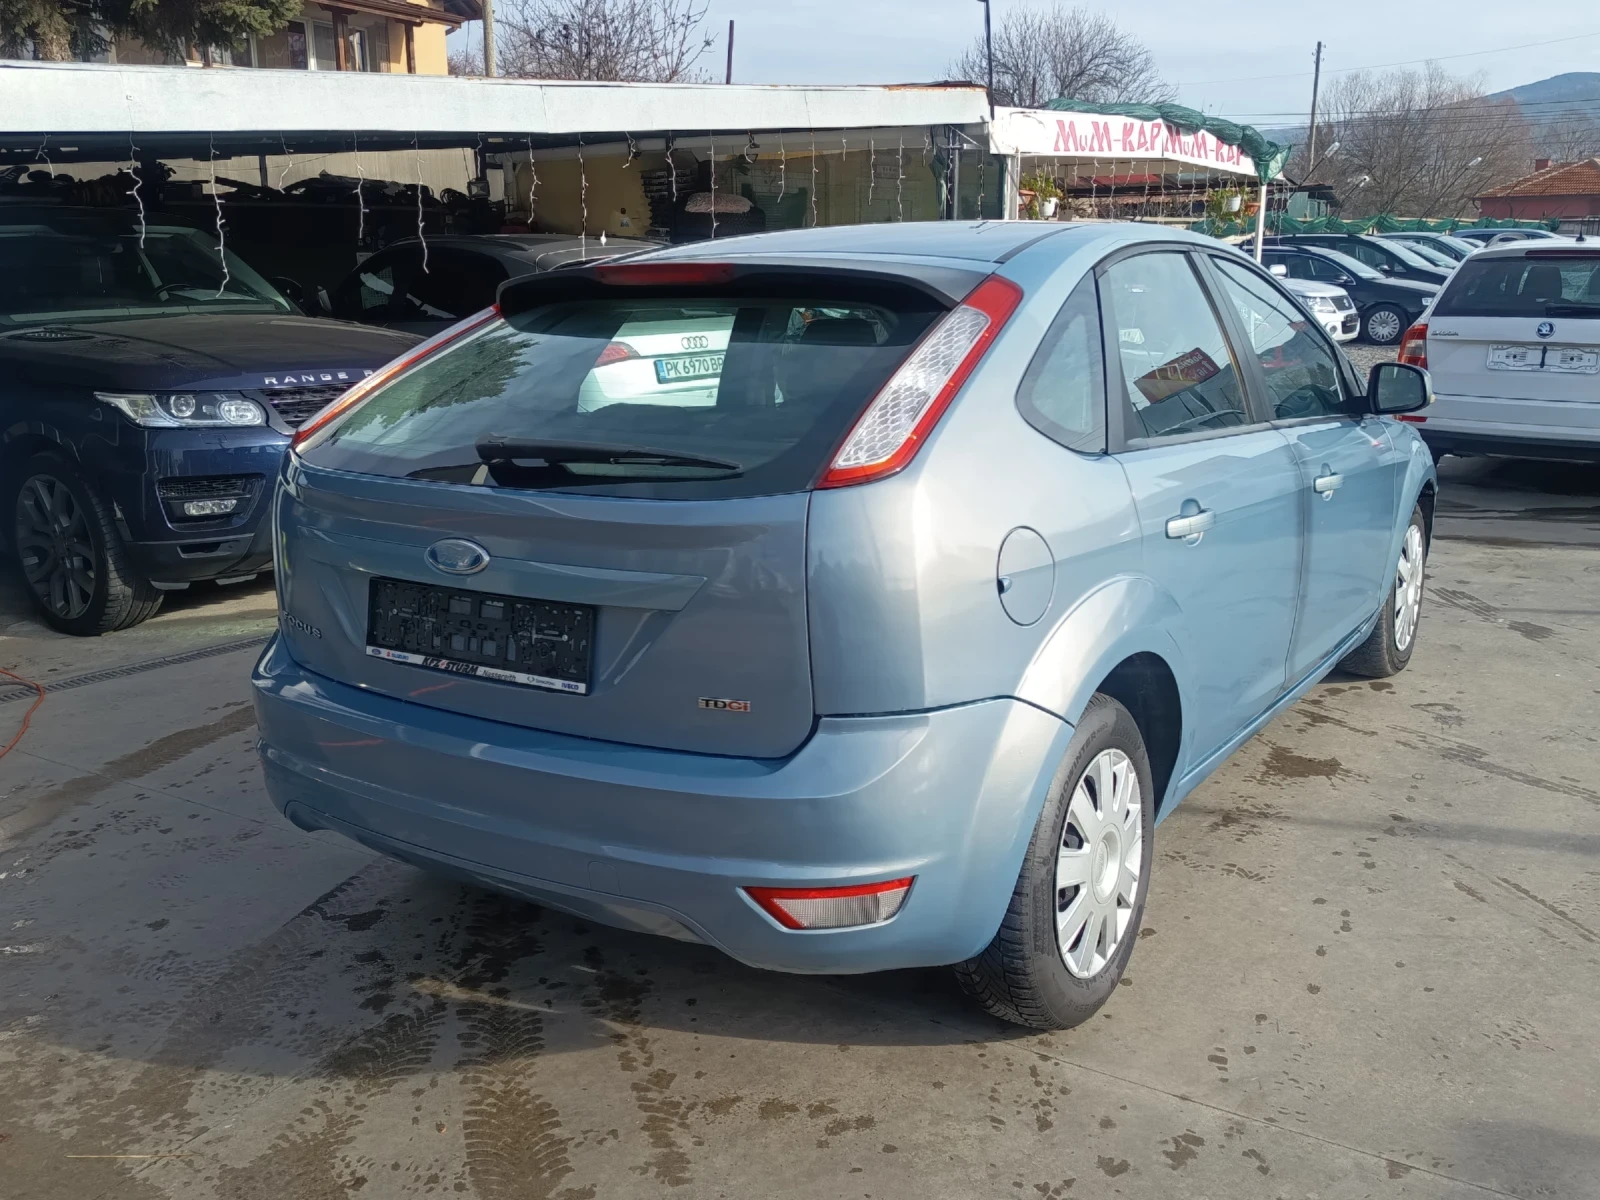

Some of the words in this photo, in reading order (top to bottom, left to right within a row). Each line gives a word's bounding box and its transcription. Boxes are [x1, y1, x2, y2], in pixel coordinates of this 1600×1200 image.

[665, 361, 681, 376] PK
[683, 358, 709, 374] 6970
[264, 371, 349, 385] RANGE
[444, 660, 480, 676] STURM
[561, 682, 579, 691] IVECO
[700, 698, 749, 712] TDCi
